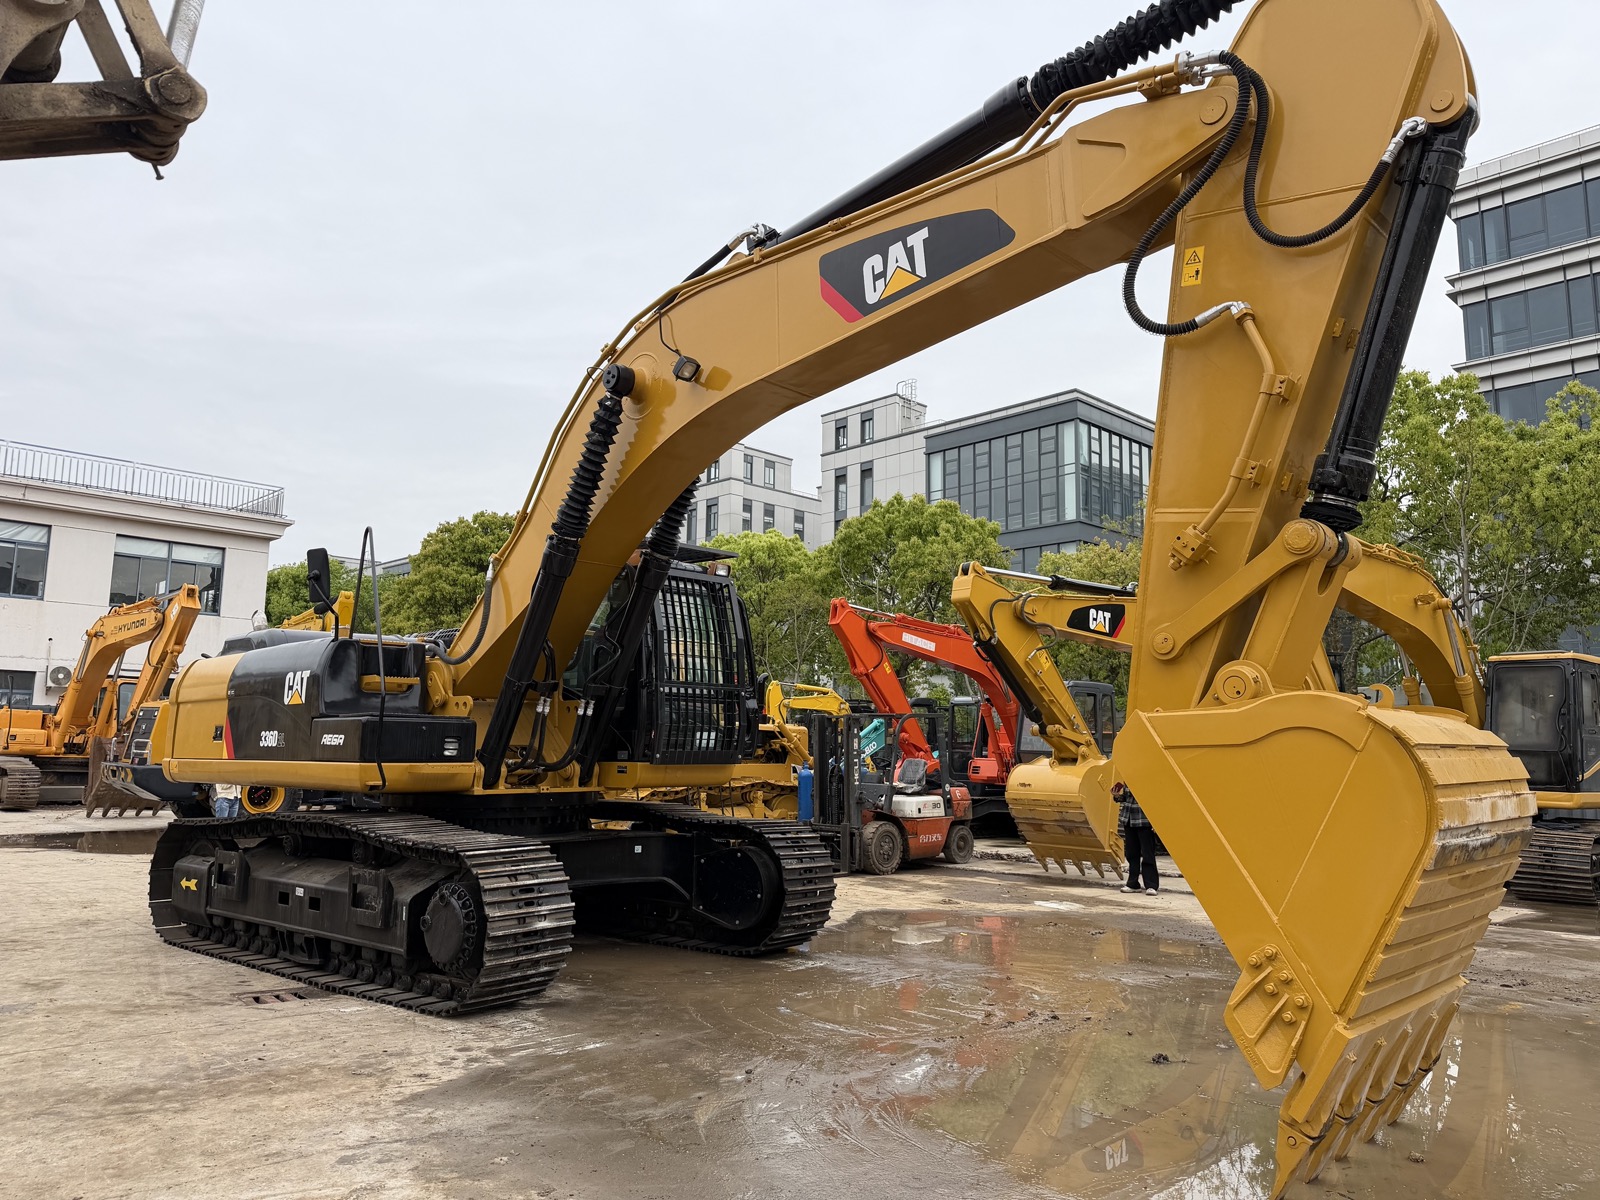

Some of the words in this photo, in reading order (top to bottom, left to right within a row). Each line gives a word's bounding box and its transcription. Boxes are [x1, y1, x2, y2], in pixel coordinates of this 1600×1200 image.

[863, 226, 929, 305] CAT
[117, 618, 147, 633] HYUNDAI
[1089, 608, 1111, 634] CAT
[283, 670, 311, 706] CAT
